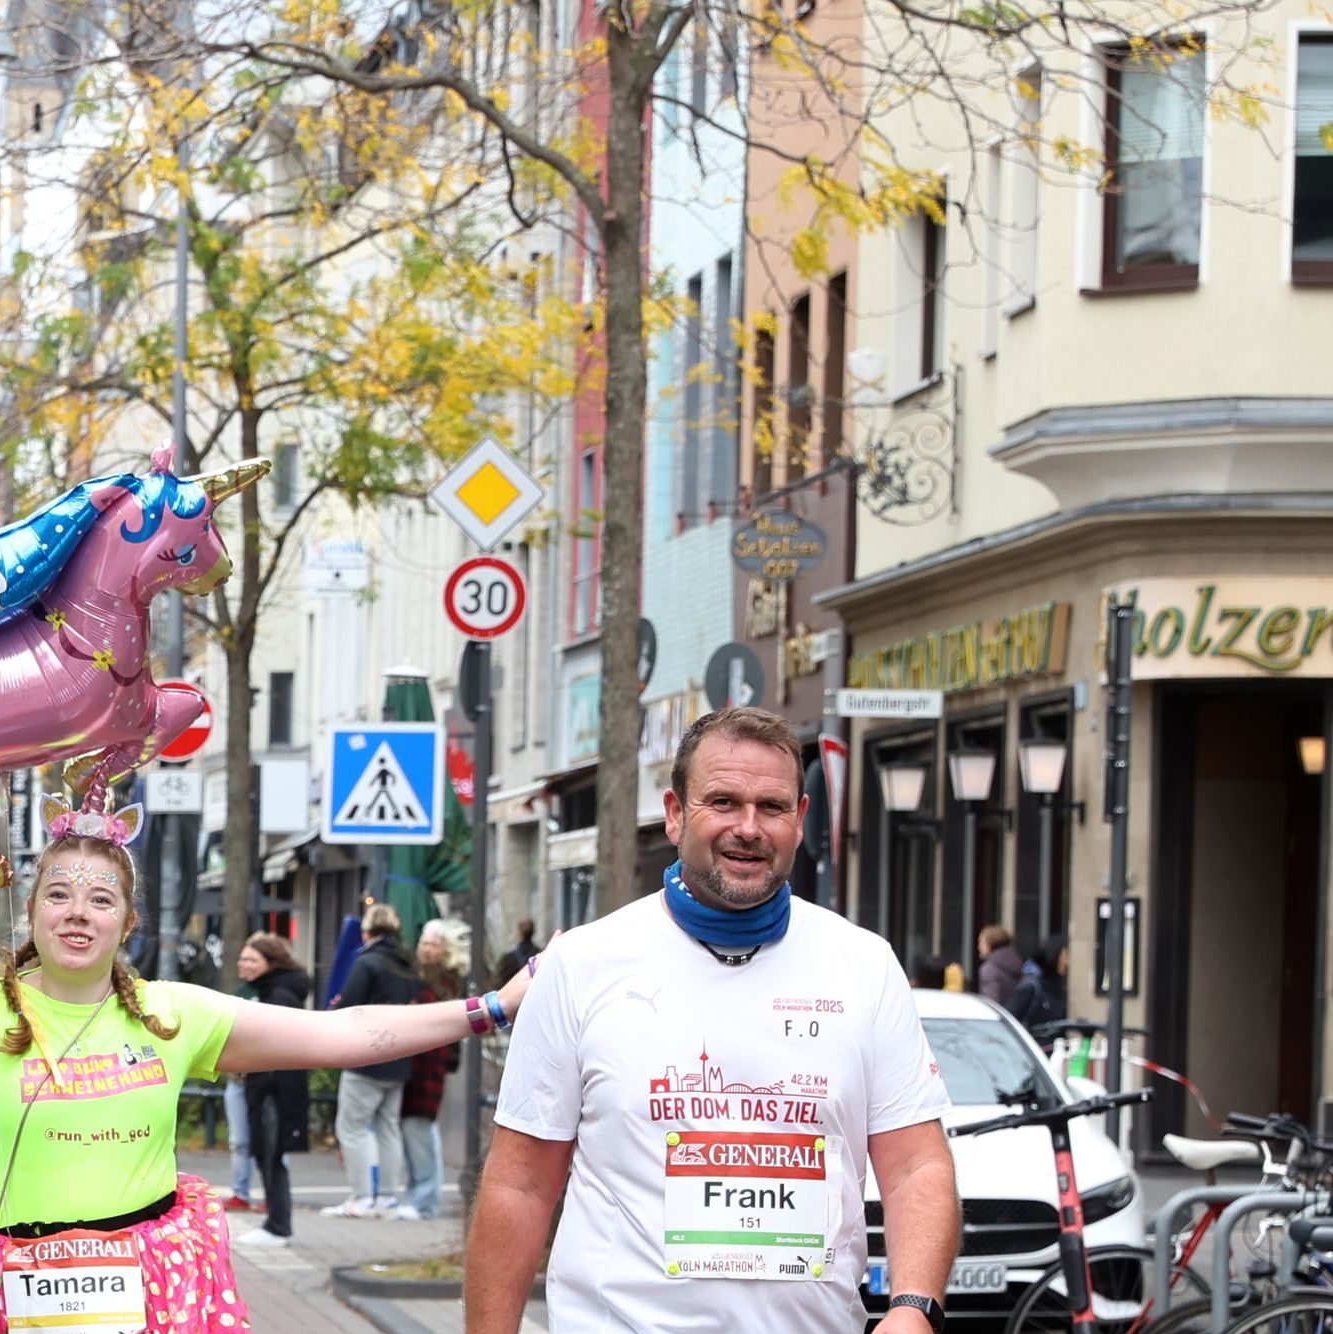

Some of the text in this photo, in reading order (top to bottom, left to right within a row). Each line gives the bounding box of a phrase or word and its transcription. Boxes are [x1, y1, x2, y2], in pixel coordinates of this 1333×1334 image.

[462, 580, 508, 615] 30
[815, 999, 844, 1013] 2025
[791, 1074, 828, 1087] 42.2 KM
[801, 1087, 828, 1095] MARATHON
[650, 1097, 824, 1125] DER DOM. DAS ZIEL.
[44, 1125, 151, 1146] @run_with_god
[709, 1143, 822, 1169] GENERALI
[704, 1181, 796, 1210] Frank
[739, 1217, 762, 1229] 151
[35, 1238, 135, 1260] GENERALI
[702, 1261, 753, 1273] MARATHON
[779, 1263, 806, 1275] PUMA
[19, 1274, 126, 1297] Tamara
[59, 1301, 86, 1312] 1821
